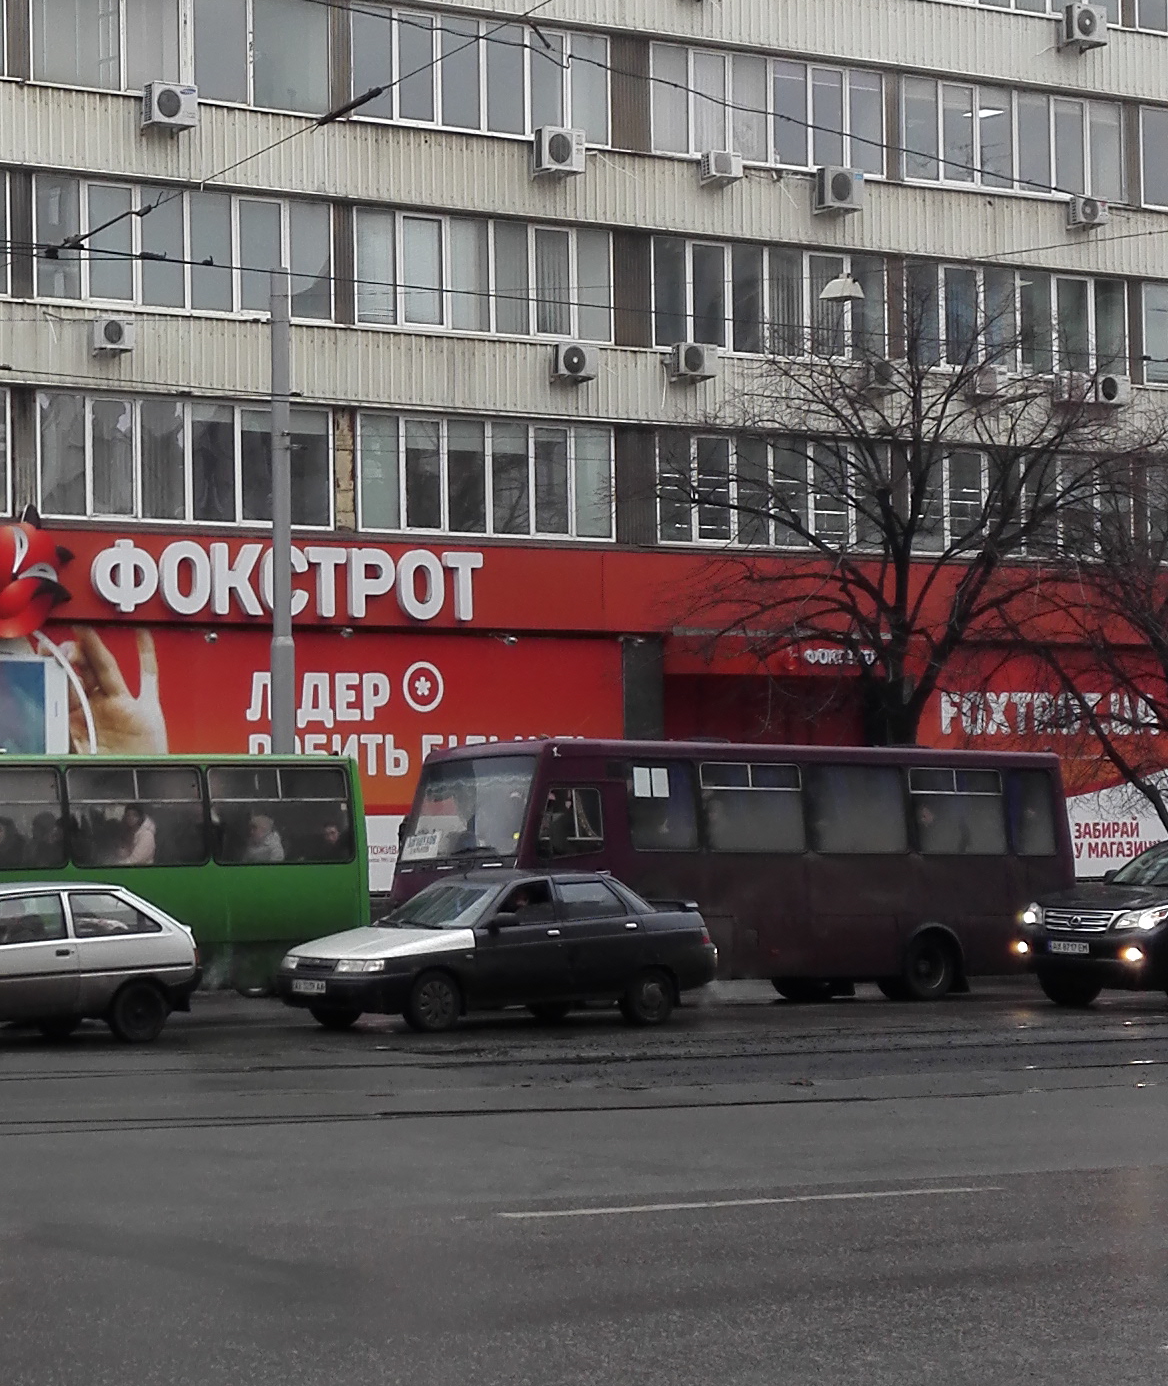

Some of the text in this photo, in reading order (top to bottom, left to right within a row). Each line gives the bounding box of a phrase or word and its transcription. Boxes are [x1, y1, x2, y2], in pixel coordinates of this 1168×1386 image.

[90, 539, 484, 621] ФОКСТРОТ
[246, 671, 390, 728] ЛДЕР
[1074, 816, 1140, 840] ЗАБИРАЙ
[1074, 842, 1084, 859] У
